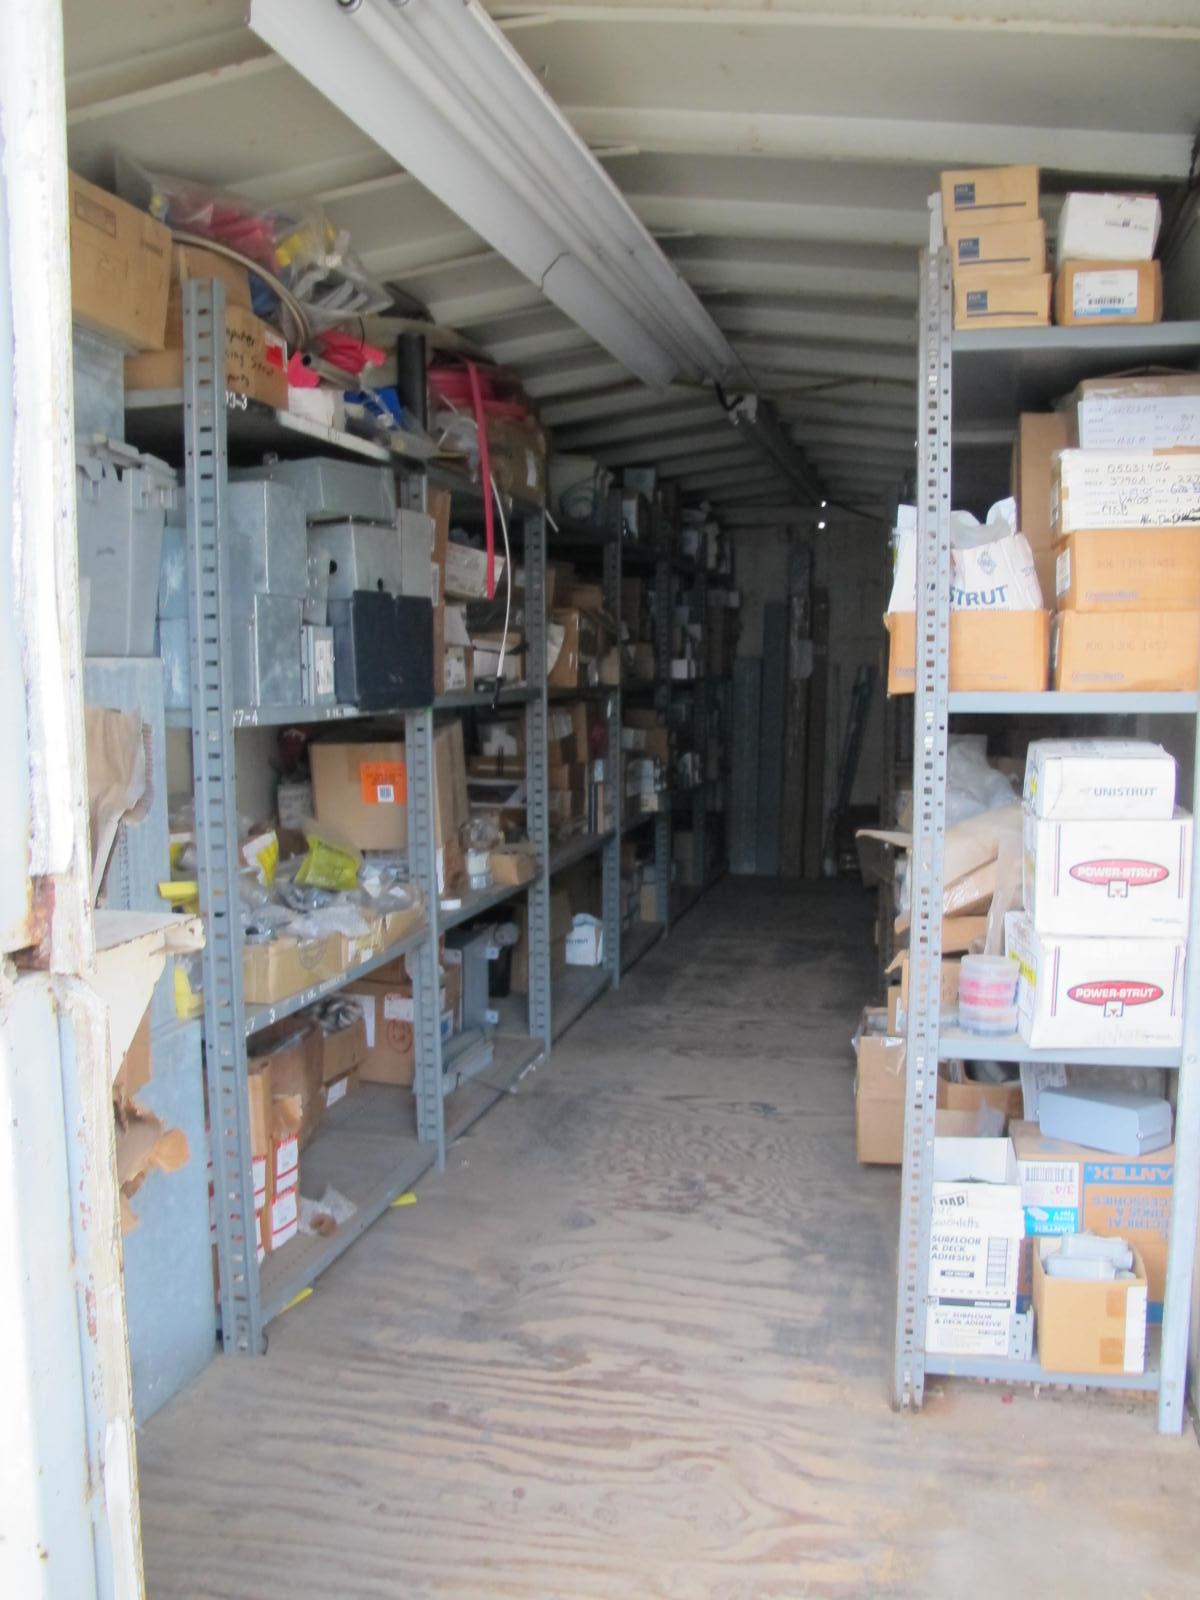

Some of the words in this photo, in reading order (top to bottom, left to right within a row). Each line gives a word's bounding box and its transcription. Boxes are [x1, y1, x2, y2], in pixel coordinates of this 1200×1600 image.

[949, 584, 1008, 606] STRUT
[1077, 865, 1162, 879] POWER-STRUT
[1075, 986, 1157, 999] POWER-STRUT
[1093, 1167, 1173, 1181] ANTEX
[931, 1233, 982, 1245] SUBFLOOR
[930, 1253, 977, 1262] ADHESIVE
